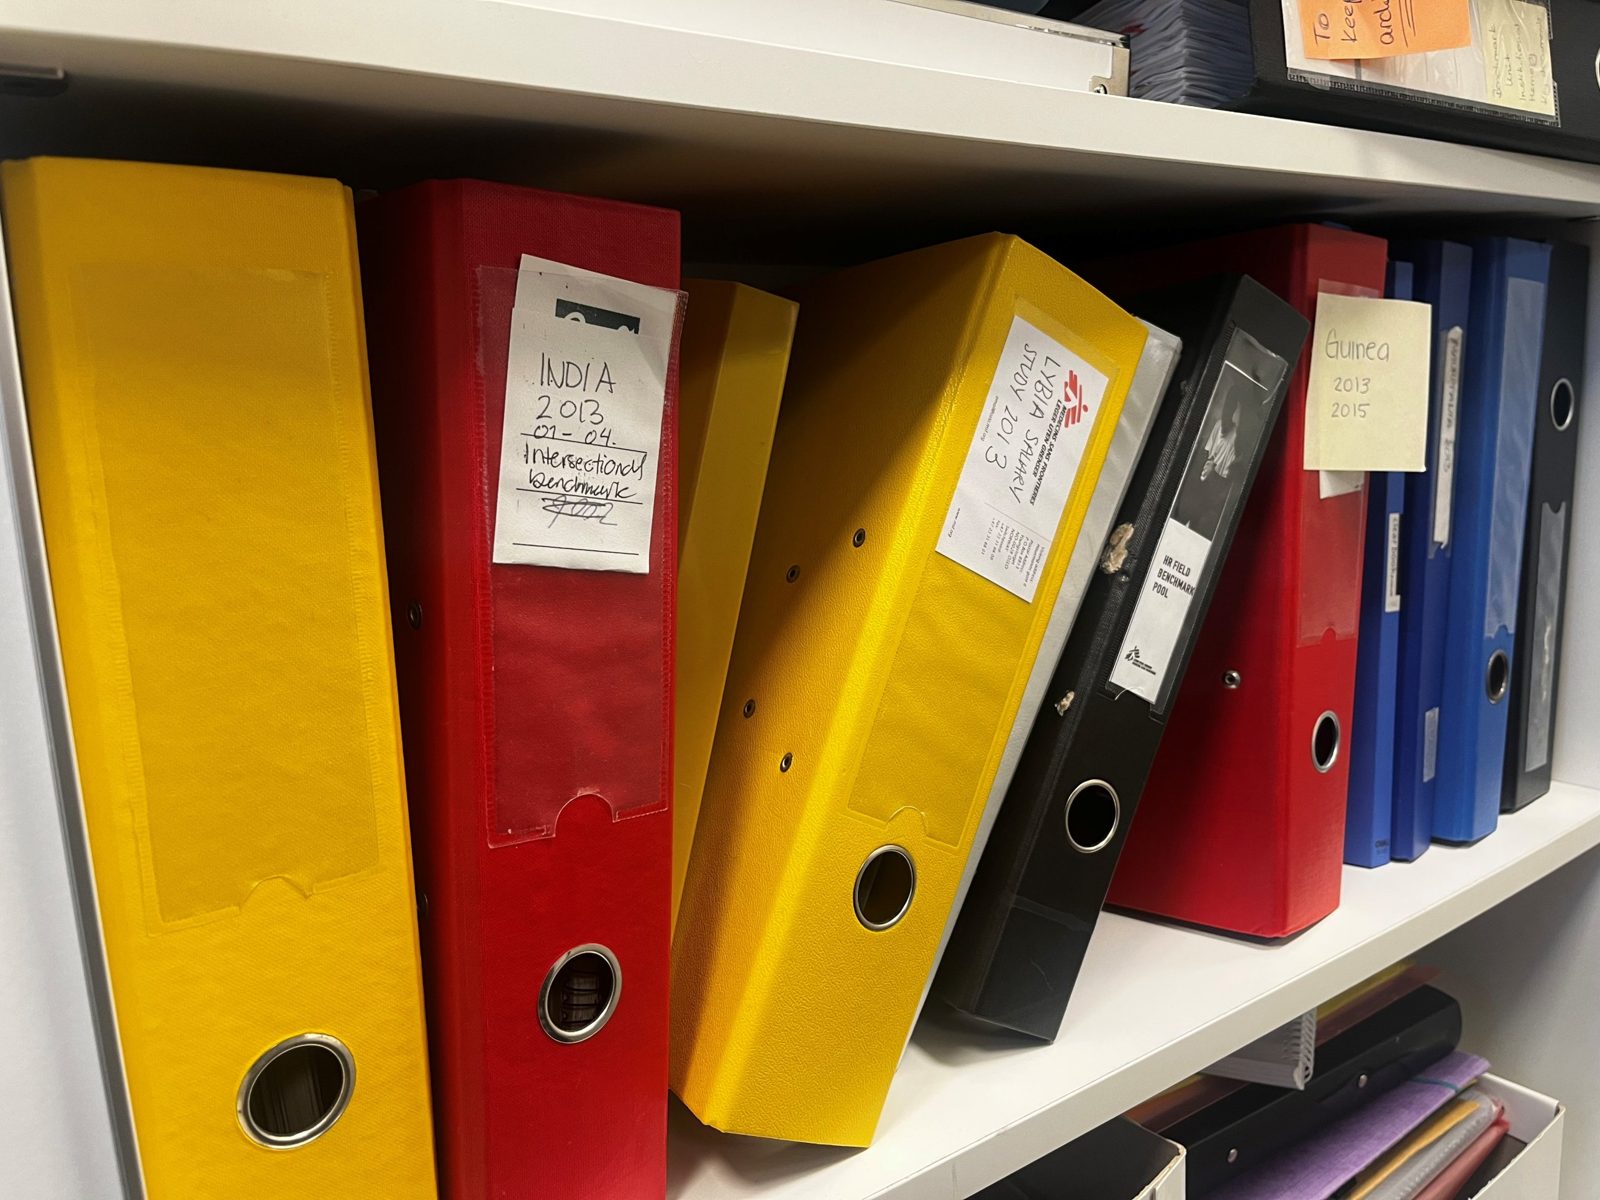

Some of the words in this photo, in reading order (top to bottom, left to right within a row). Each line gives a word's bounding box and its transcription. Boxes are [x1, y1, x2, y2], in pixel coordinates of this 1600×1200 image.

[1313, 12, 1331, 46] To
[1325, 327, 1390, 362] Guinea
[540, 352, 617, 394] INDIA
[1010, 344, 1037, 401] STUDY
[1029, 356, 1060, 419] LYBIA
[1333, 376, 1371, 394] 2013
[536, 395, 604, 425] 2013
[1051, 399, 1062, 423] LEGER
[1052, 405, 1067, 441] MEDECINS
[1331, 402, 1370, 418] 2015
[1044, 423, 1054, 444] UTEN
[1009, 429, 1039, 503] SALARY
[1033, 444, 1047, 477] GRENSER
[1045, 442, 1054, 461] SANS
[1030, 462, 1048, 505] FRONTIERES
[1162, 554, 1173, 568] HR
[1172, 560, 1191, 577] FIELD
[1152, 581, 1169, 599] POOL
[1157, 568, 1196, 596] BENCHMARK
